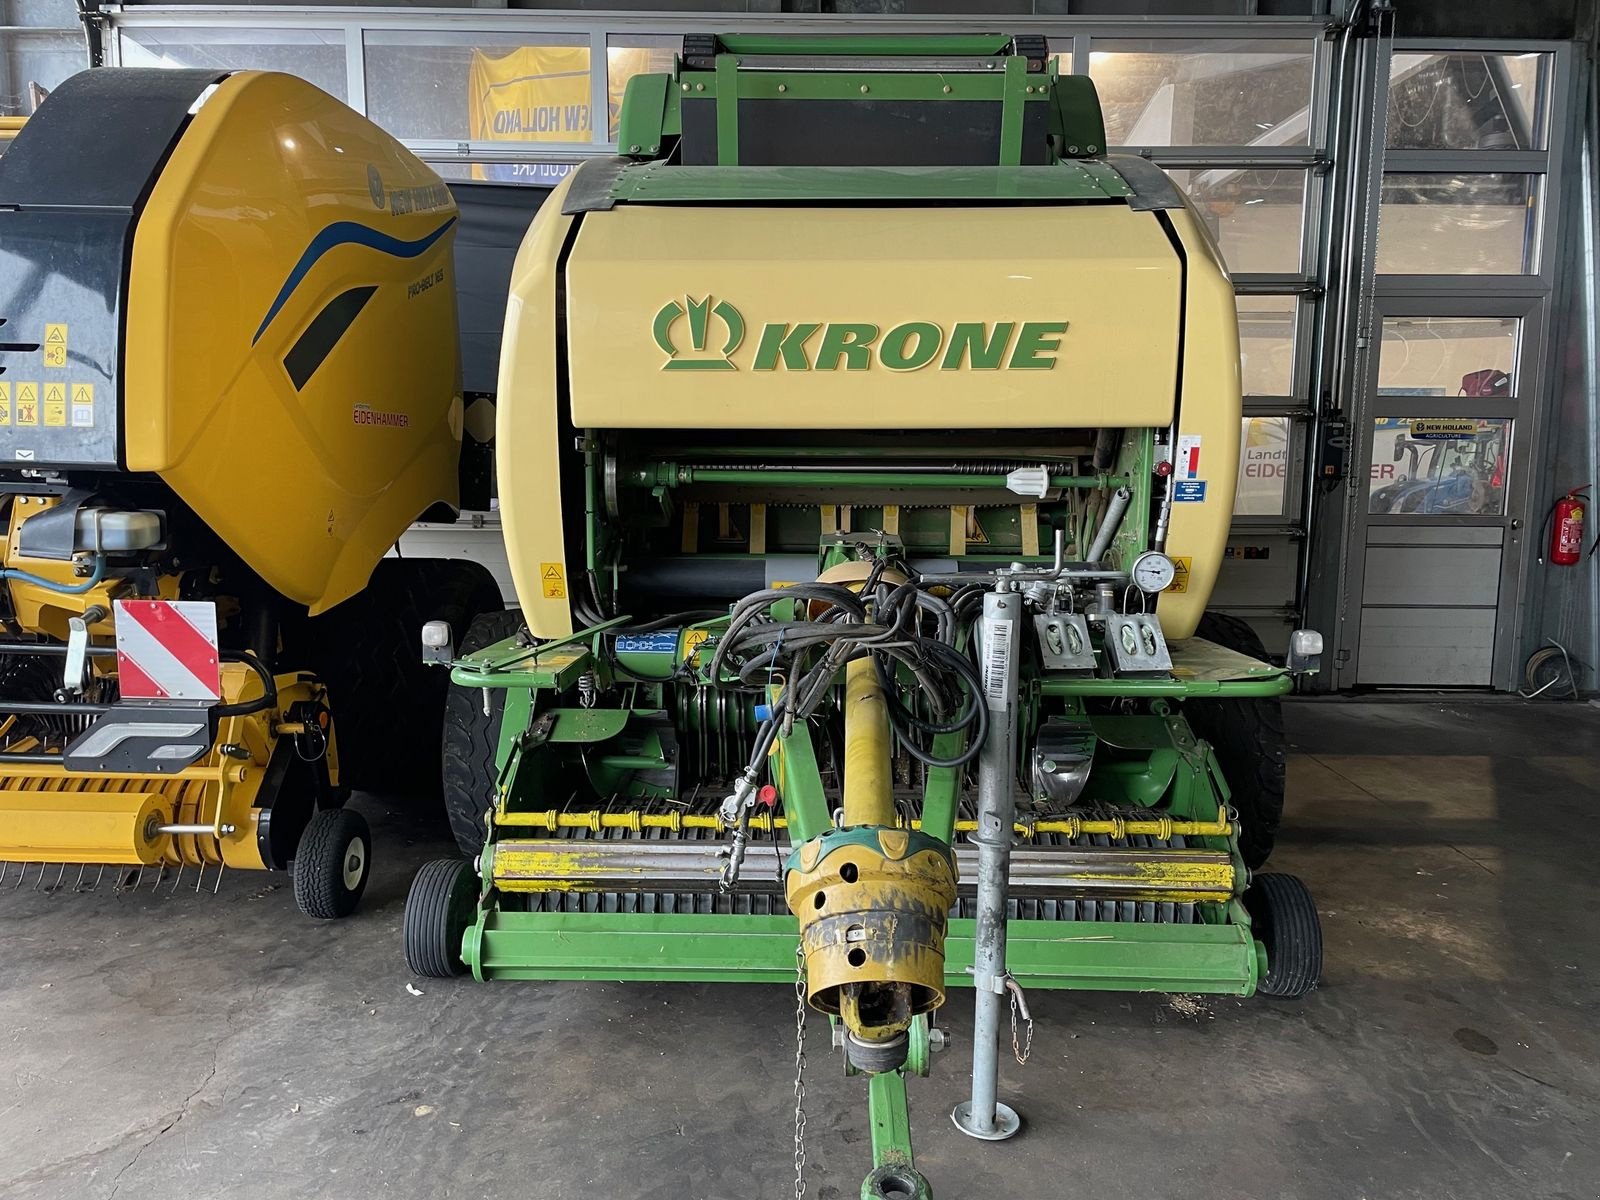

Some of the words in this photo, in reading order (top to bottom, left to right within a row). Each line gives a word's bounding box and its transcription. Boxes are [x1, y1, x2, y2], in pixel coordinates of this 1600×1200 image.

[390, 188, 412, 216] NEW
[414, 182, 449, 211] HOLLAND
[752, 321, 1070, 371] KRONE
[353, 409, 409, 427] EIDENHAMMER
